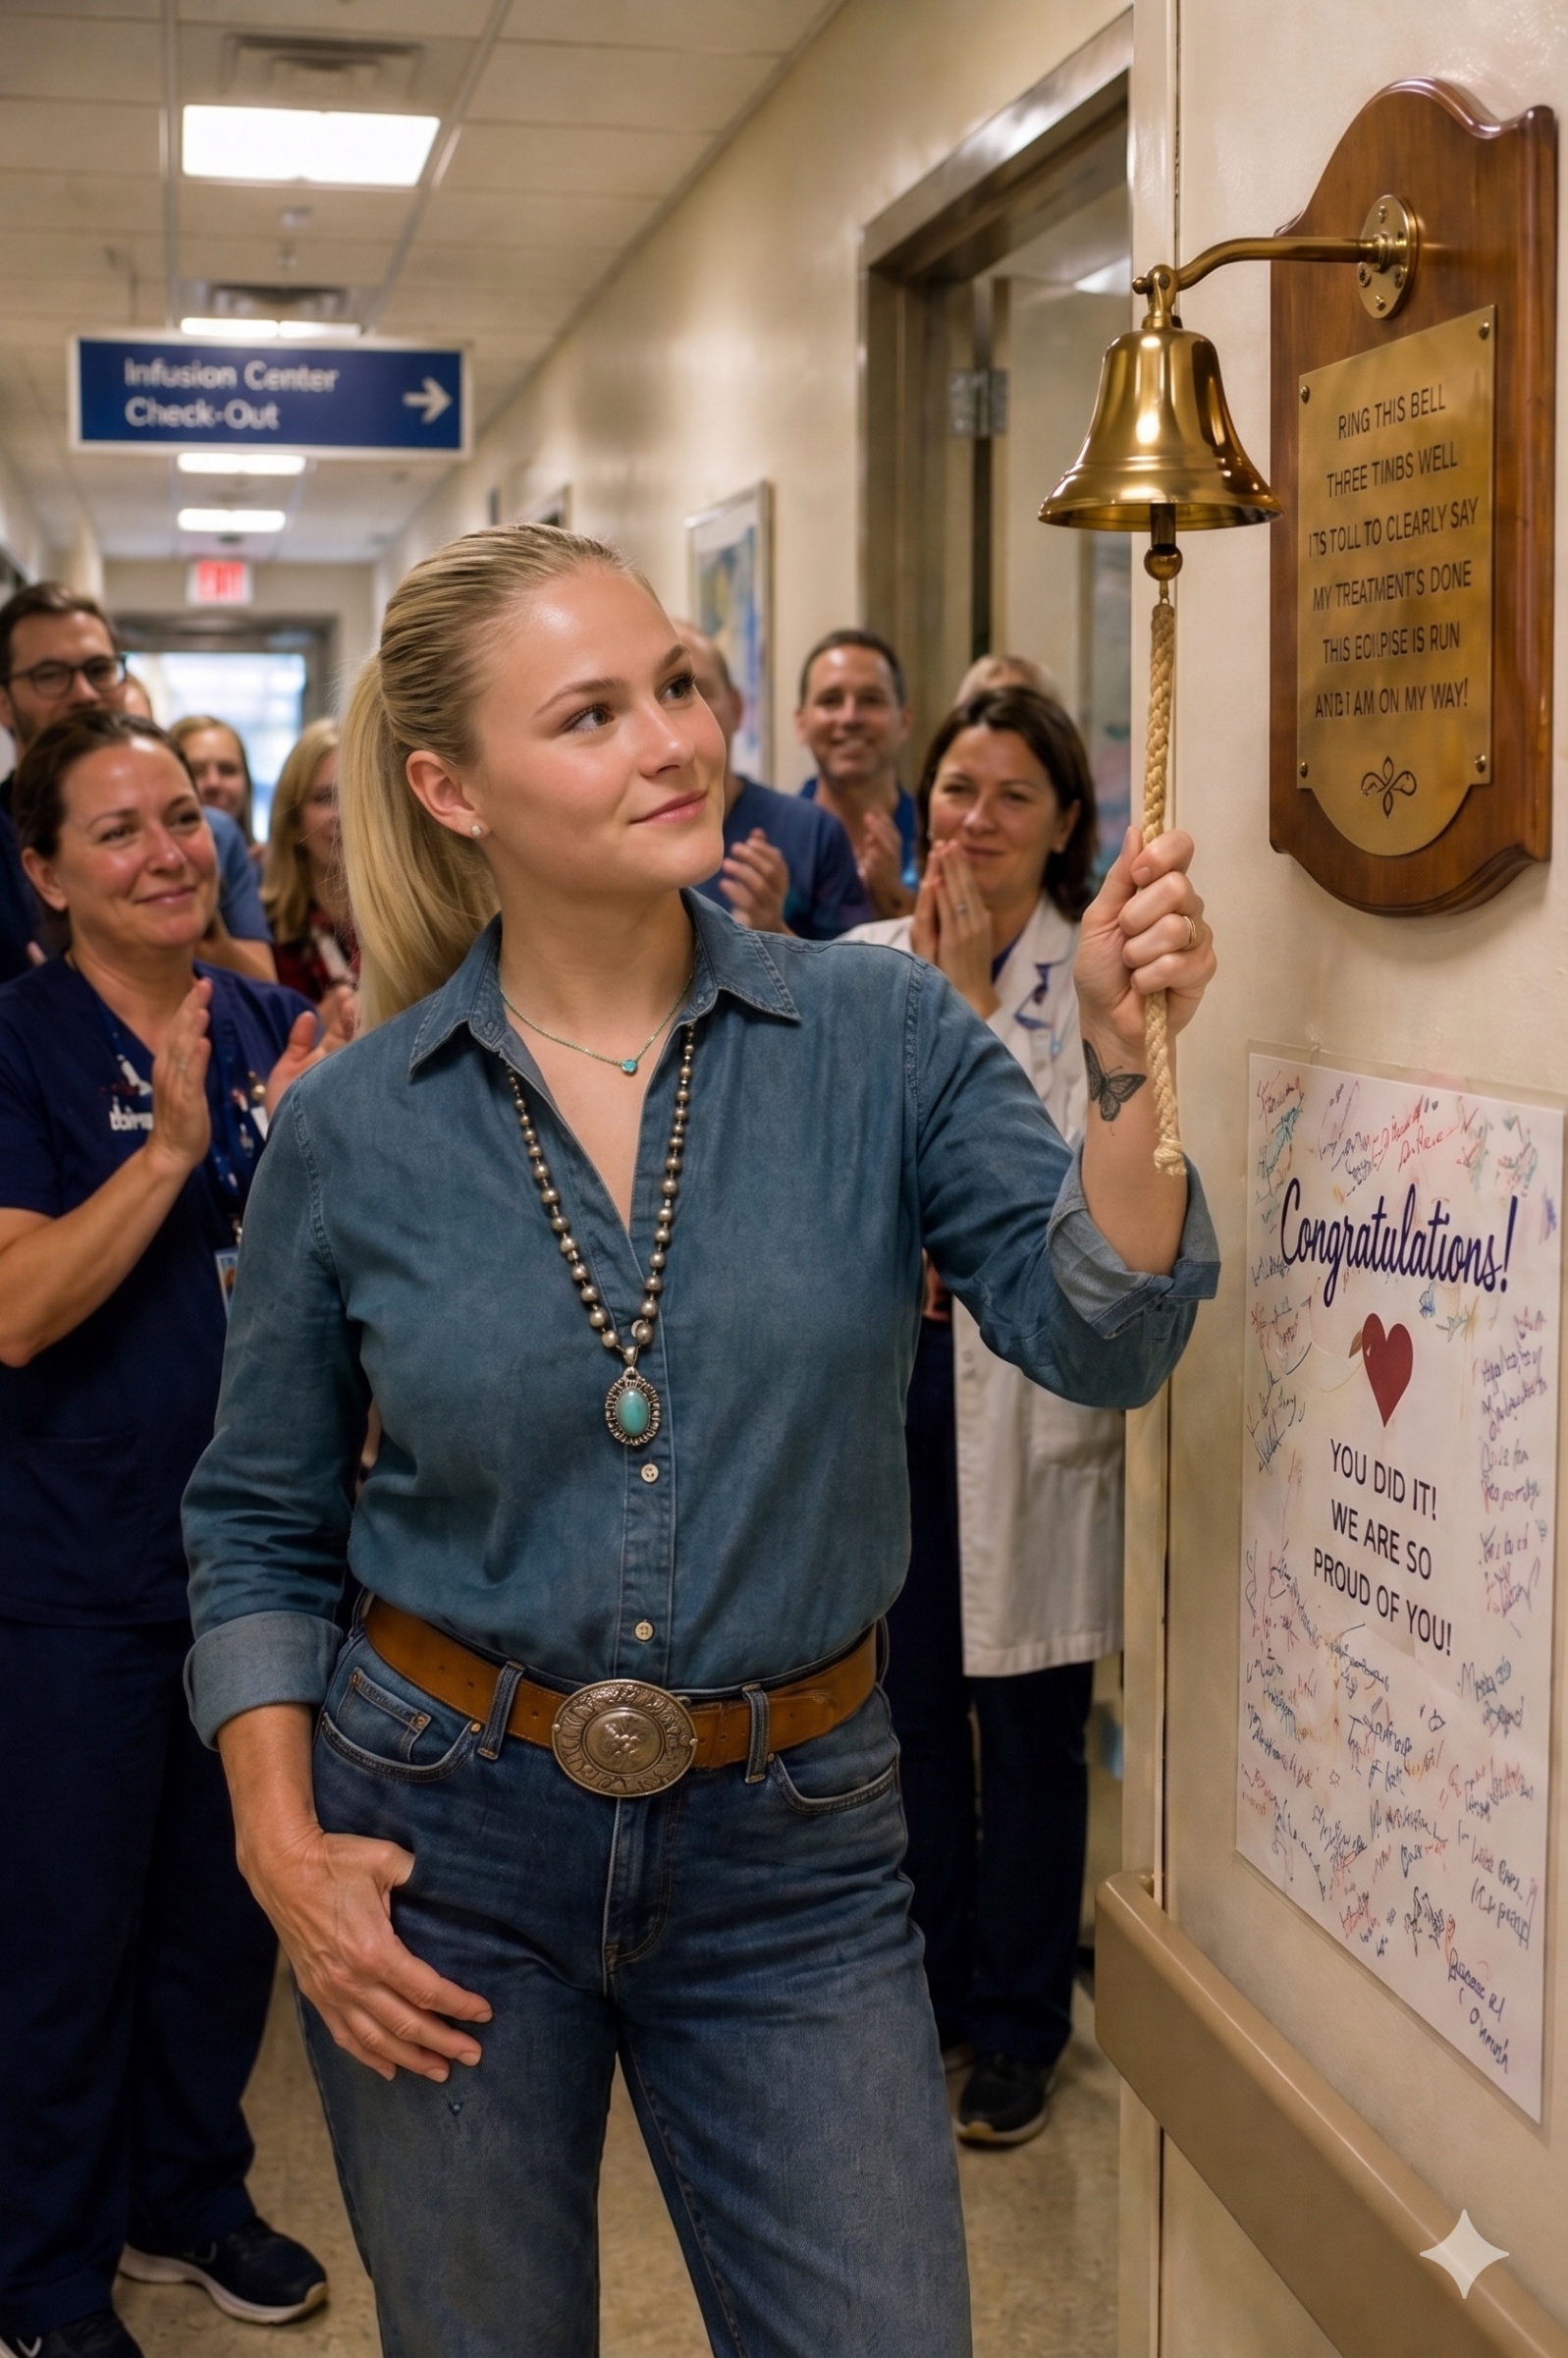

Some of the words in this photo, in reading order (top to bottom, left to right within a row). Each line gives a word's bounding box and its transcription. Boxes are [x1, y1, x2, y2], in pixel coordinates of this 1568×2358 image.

[124, 356, 238, 390] Infusion
[243, 359, 340, 393] Center
[124, 396, 281, 430] Check-Out
[1338, 408, 1370, 440] RING
[1375, 396, 1406, 428] THIS
[1411, 384, 1446, 418] BELL
[1326, 465, 1368, 498] THREE
[1419, 441, 1458, 475] WELL
[1329, 523, 1361, 553] TOLL
[1364, 518, 1381, 546] TO
[1386, 504, 1447, 541] CLEARLY
[1450, 497, 1479, 529] SAY
[1313, 585, 1332, 612] MY
[1335, 569, 1426, 608] TREATMENT'S
[1431, 560, 1472, 593] DONE
[1323, 636, 1350, 664] THIS
[1412, 627, 1425, 654] IS
[1430, 621, 1460, 651] RUN
[1353, 689, 1374, 716] AM
[1379, 687, 1399, 714] ON
[1404, 685, 1426, 712] MY
[1431, 677, 1469, 709] WAY!
[1280, 1178, 1518, 1308] Congratulations!
[1330, 1438, 1367, 1485] YOU
[1374, 1459, 1406, 1504] DID
[1413, 1478, 1436, 1521] IT!
[1331, 1499, 1358, 1542] WE
[1364, 1518, 1400, 1565] ARE
[1406, 1540, 1432, 1580] SO
[1314, 1547, 1371, 1606] PROUD
[1377, 1584, 1400, 1622] OF
[1406, 1599, 1451, 1657] YOU!
